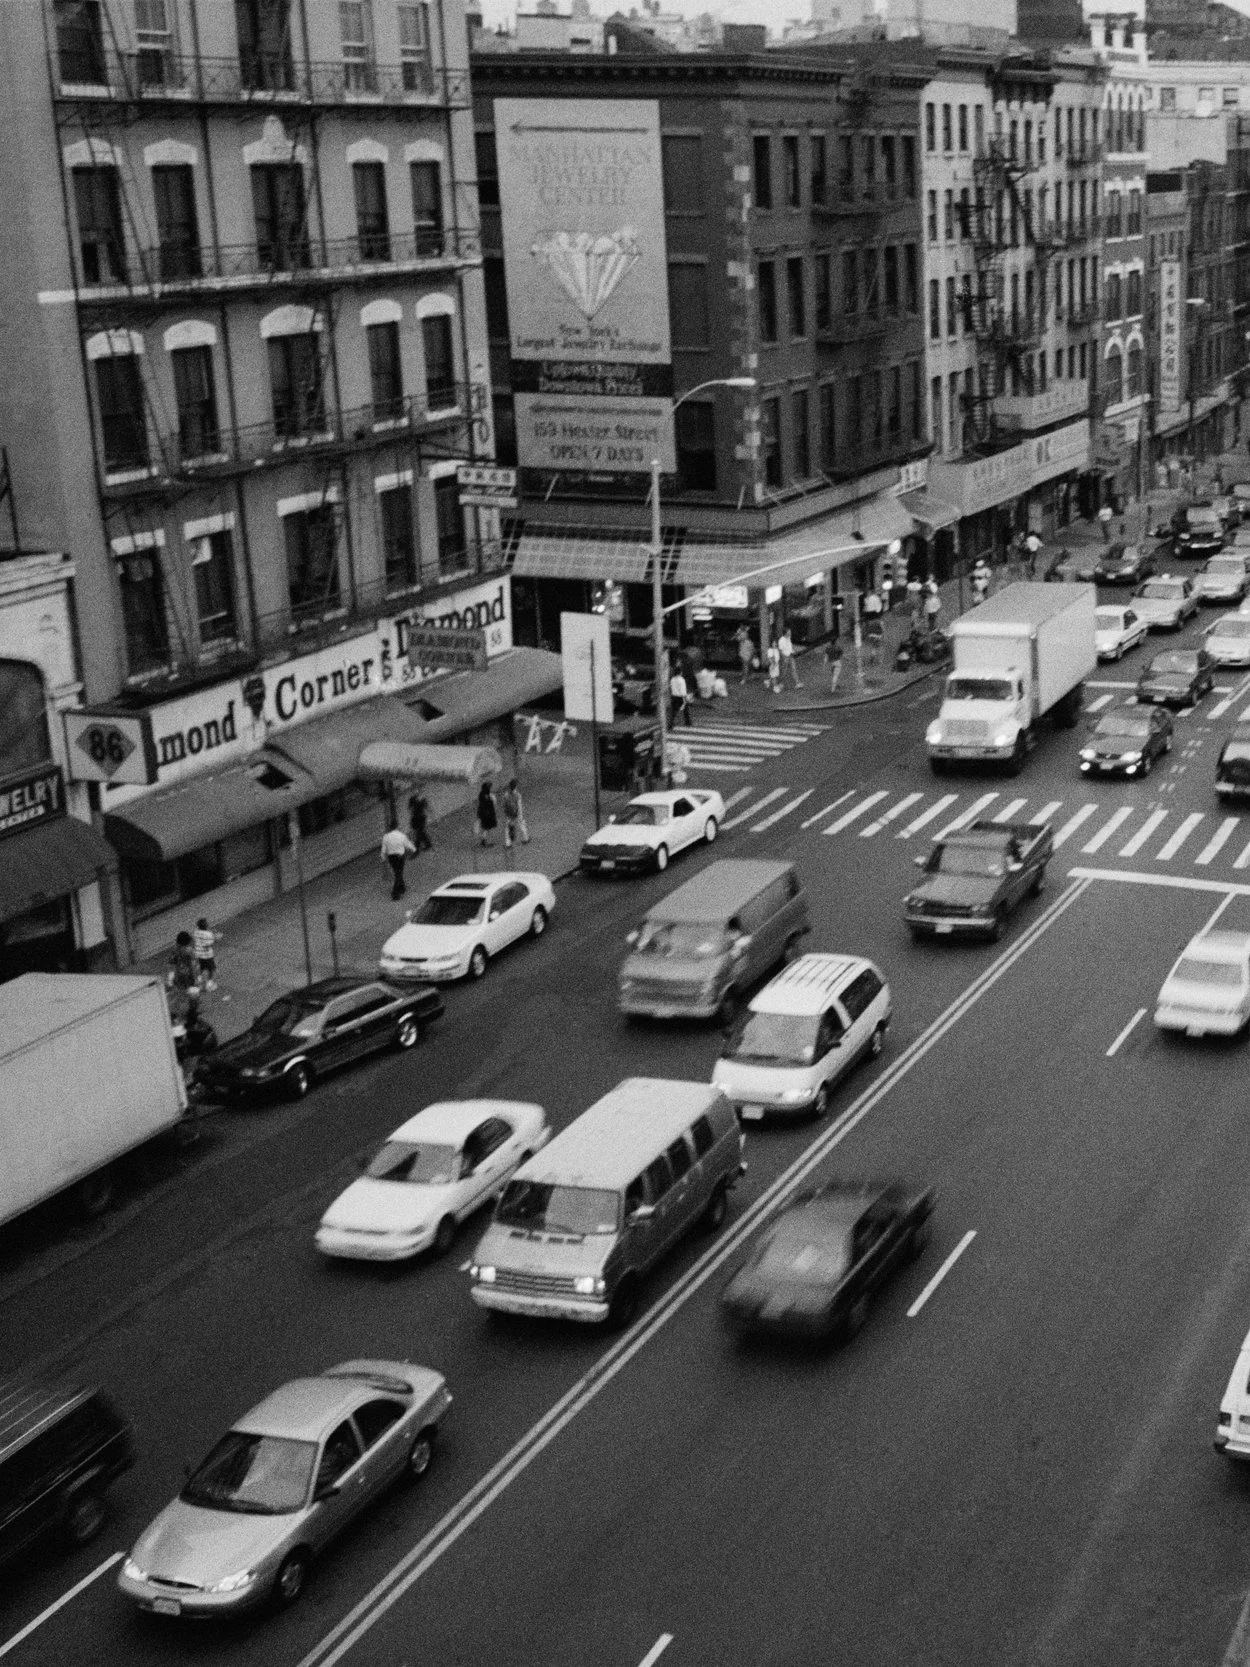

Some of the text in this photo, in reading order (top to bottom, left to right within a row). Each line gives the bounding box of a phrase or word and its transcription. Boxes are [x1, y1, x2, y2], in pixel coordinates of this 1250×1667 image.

[509, 143, 652, 164] MANHATTAN
[528, 164, 632, 185] JEWELRY
[539, 186, 627, 205] CENTER
[562, 422, 610, 438] Hester
[615, 424, 658, 442] Street
[550, 444, 643, 462] OPEN 7 DAYS
[158, 700, 237, 766] mond
[275, 658, 374, 721] Corner
[89, 729, 124, 763] 86
